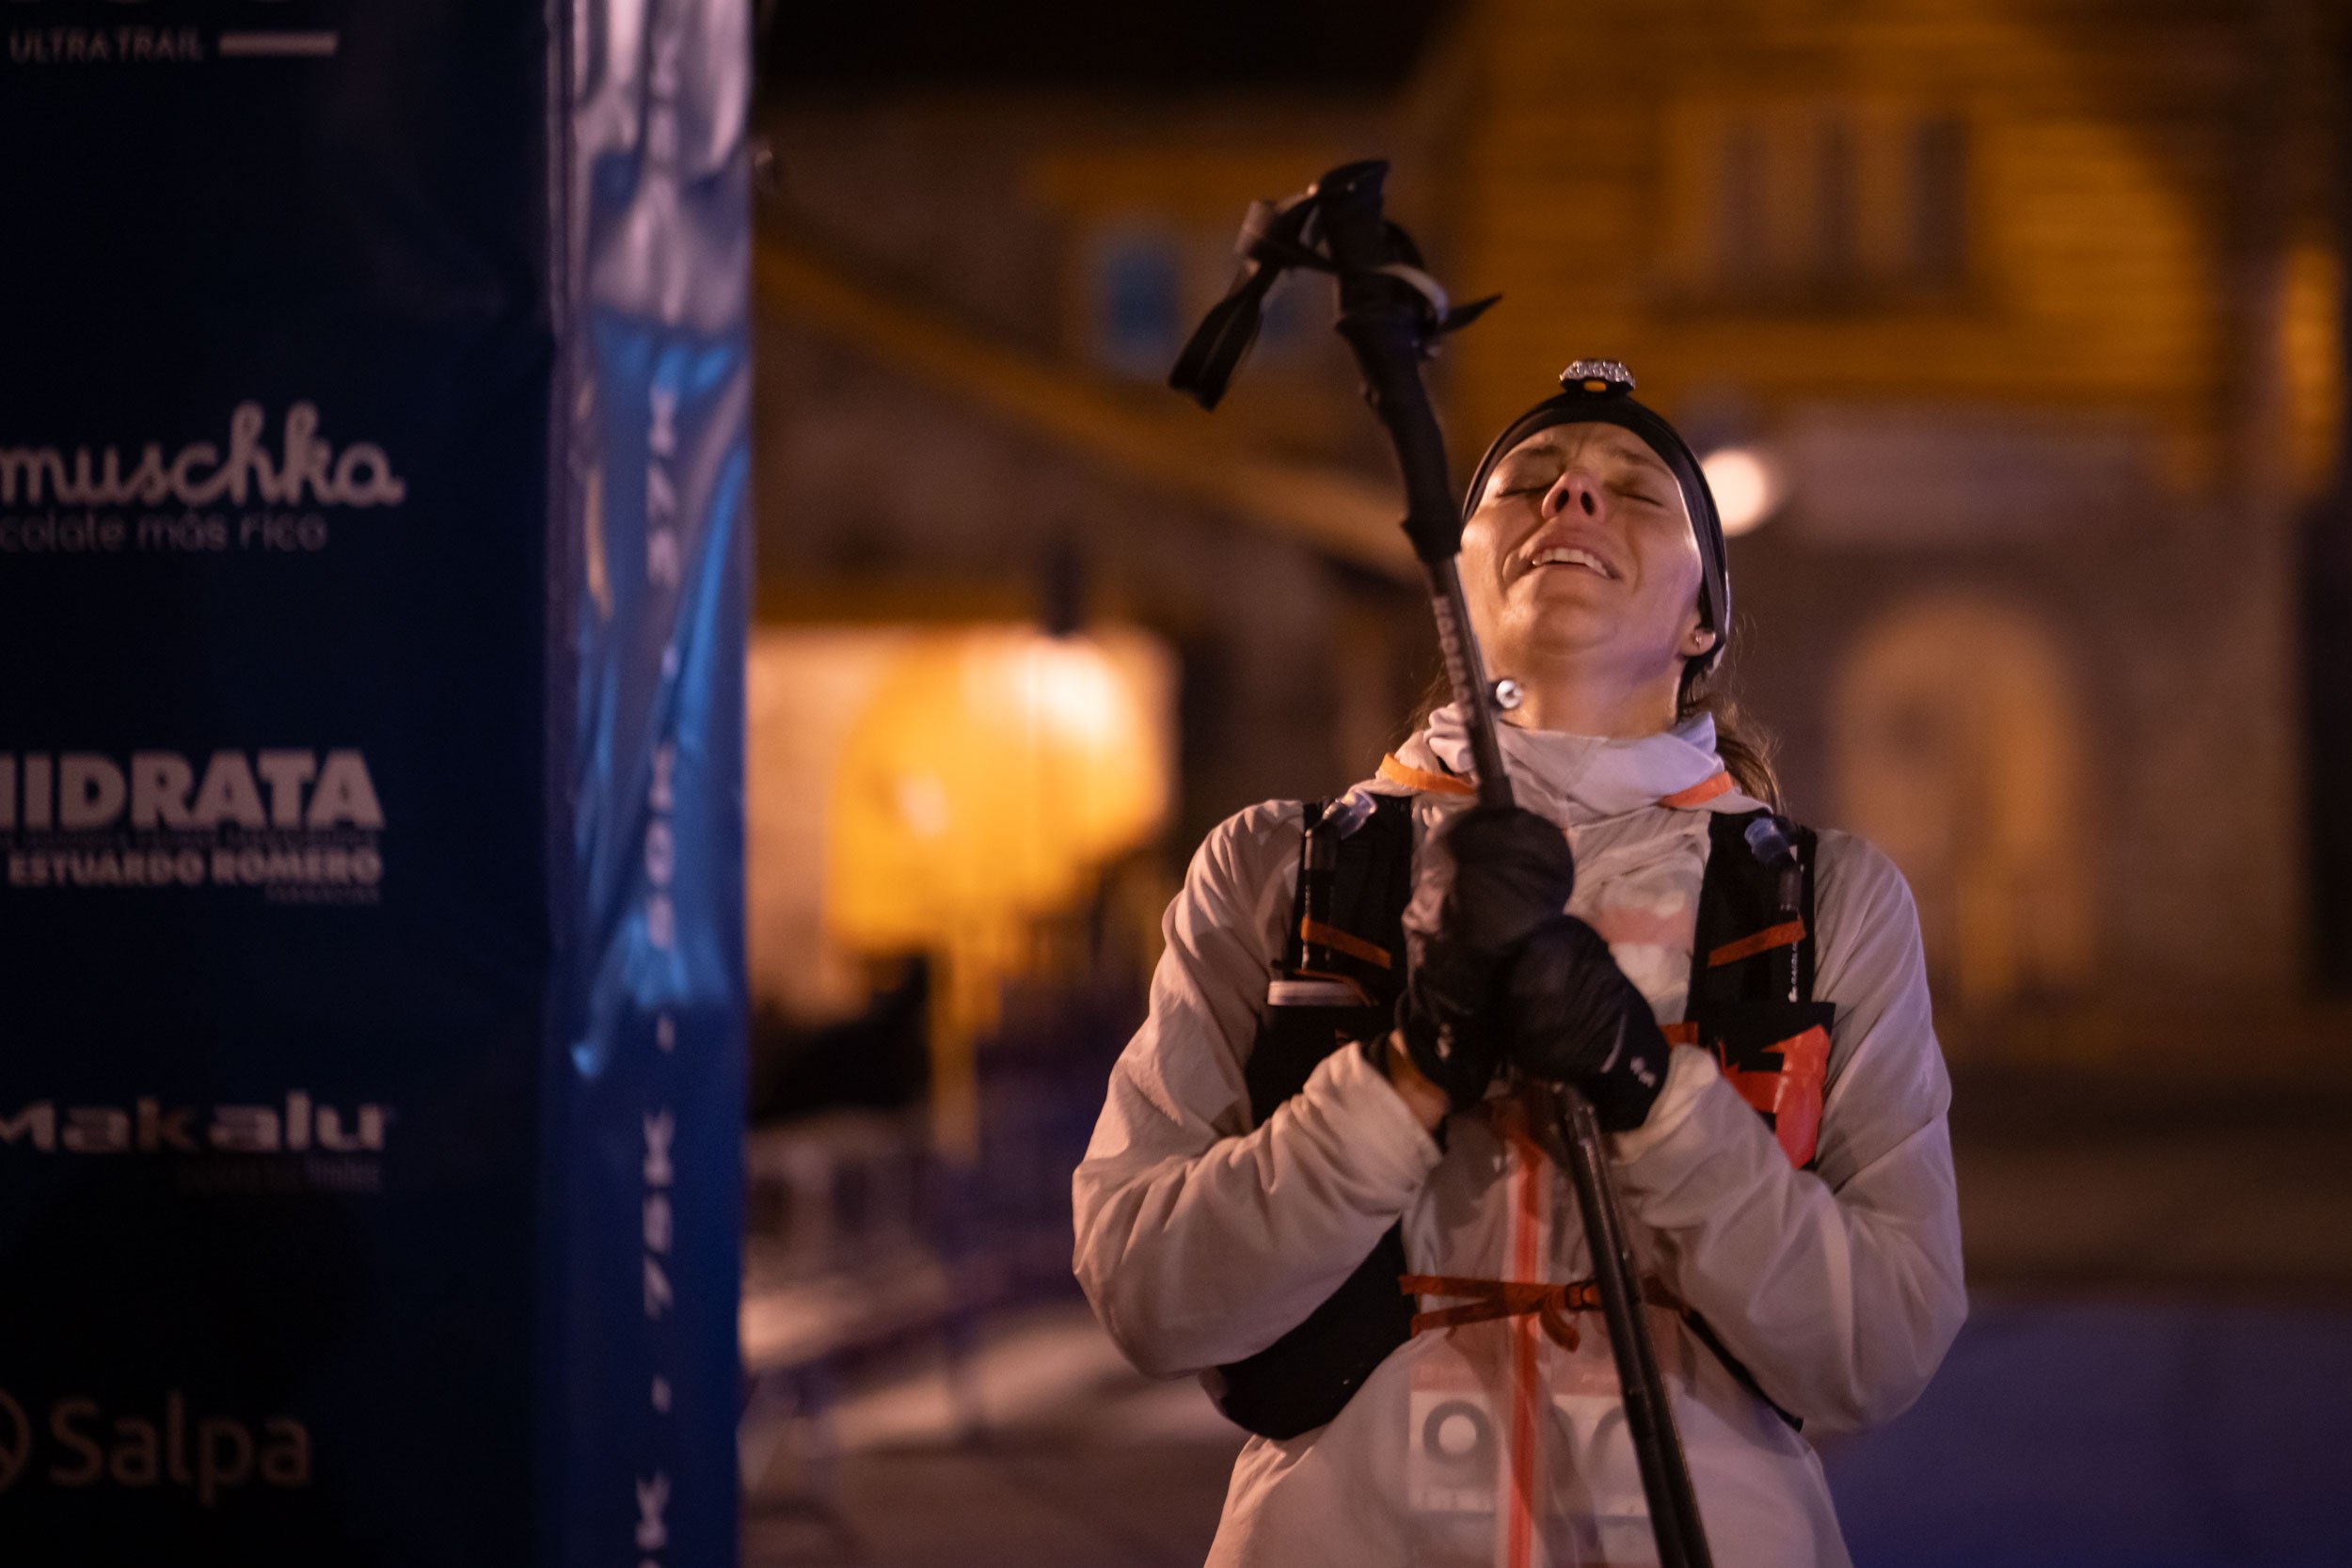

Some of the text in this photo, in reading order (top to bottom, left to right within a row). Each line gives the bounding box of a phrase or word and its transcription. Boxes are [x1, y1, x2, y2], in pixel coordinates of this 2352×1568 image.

[8, 24, 204, 64] ULTRA TRAIL
[238, 508, 328, 553] rico
[8, 849, 384, 887] ESTUARDO ROMERO
[47, 1386, 314, 1508] Salpa
